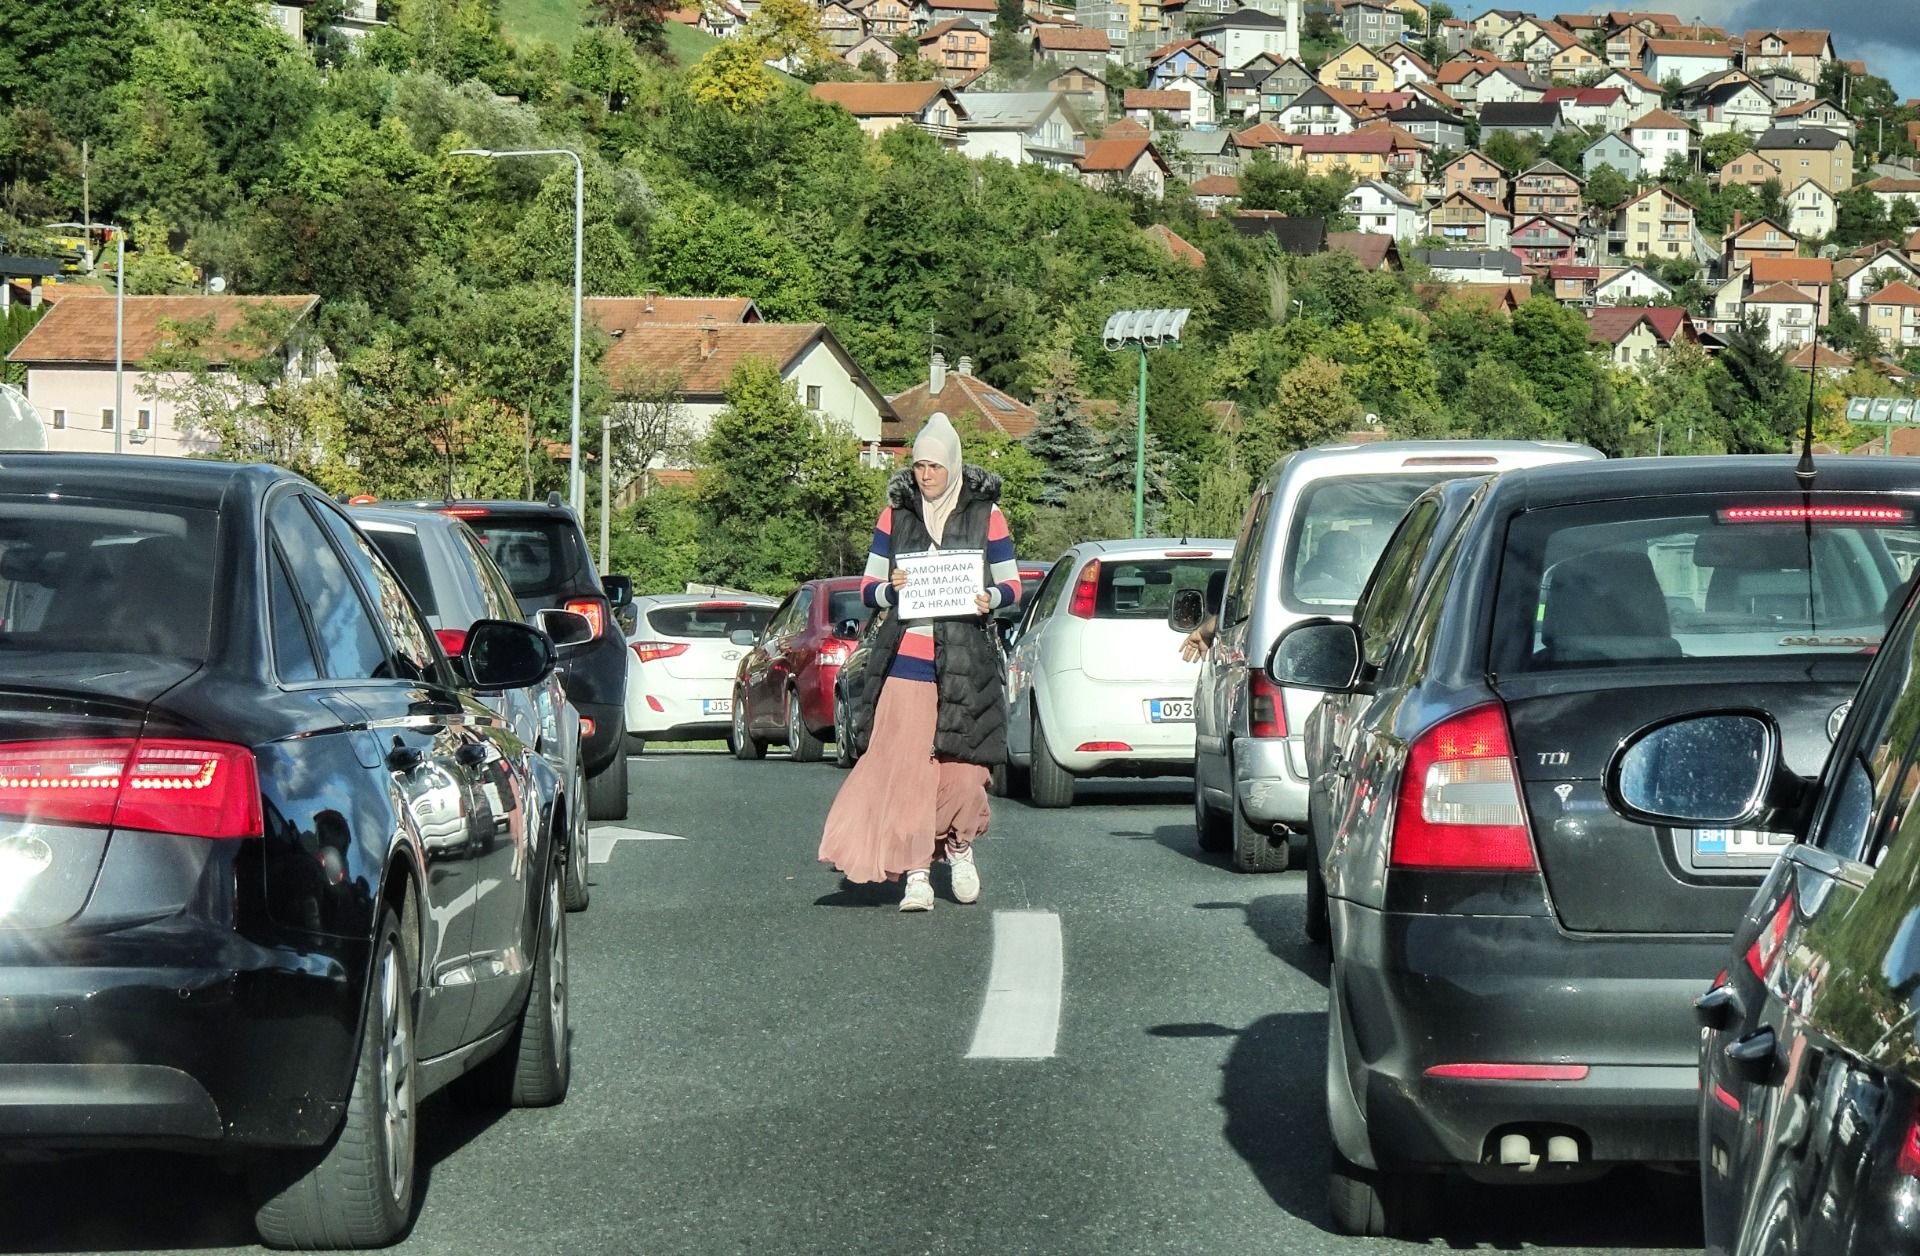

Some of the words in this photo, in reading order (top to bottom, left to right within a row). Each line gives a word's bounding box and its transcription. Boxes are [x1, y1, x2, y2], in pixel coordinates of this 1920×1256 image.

[905, 562, 974, 575] SAMOHRANA
[907, 577, 930, 587] SAM
[911, 601, 926, 610] ZA
[1163, 703, 1193, 717] 093
[1537, 752, 1570, 765] TDI
